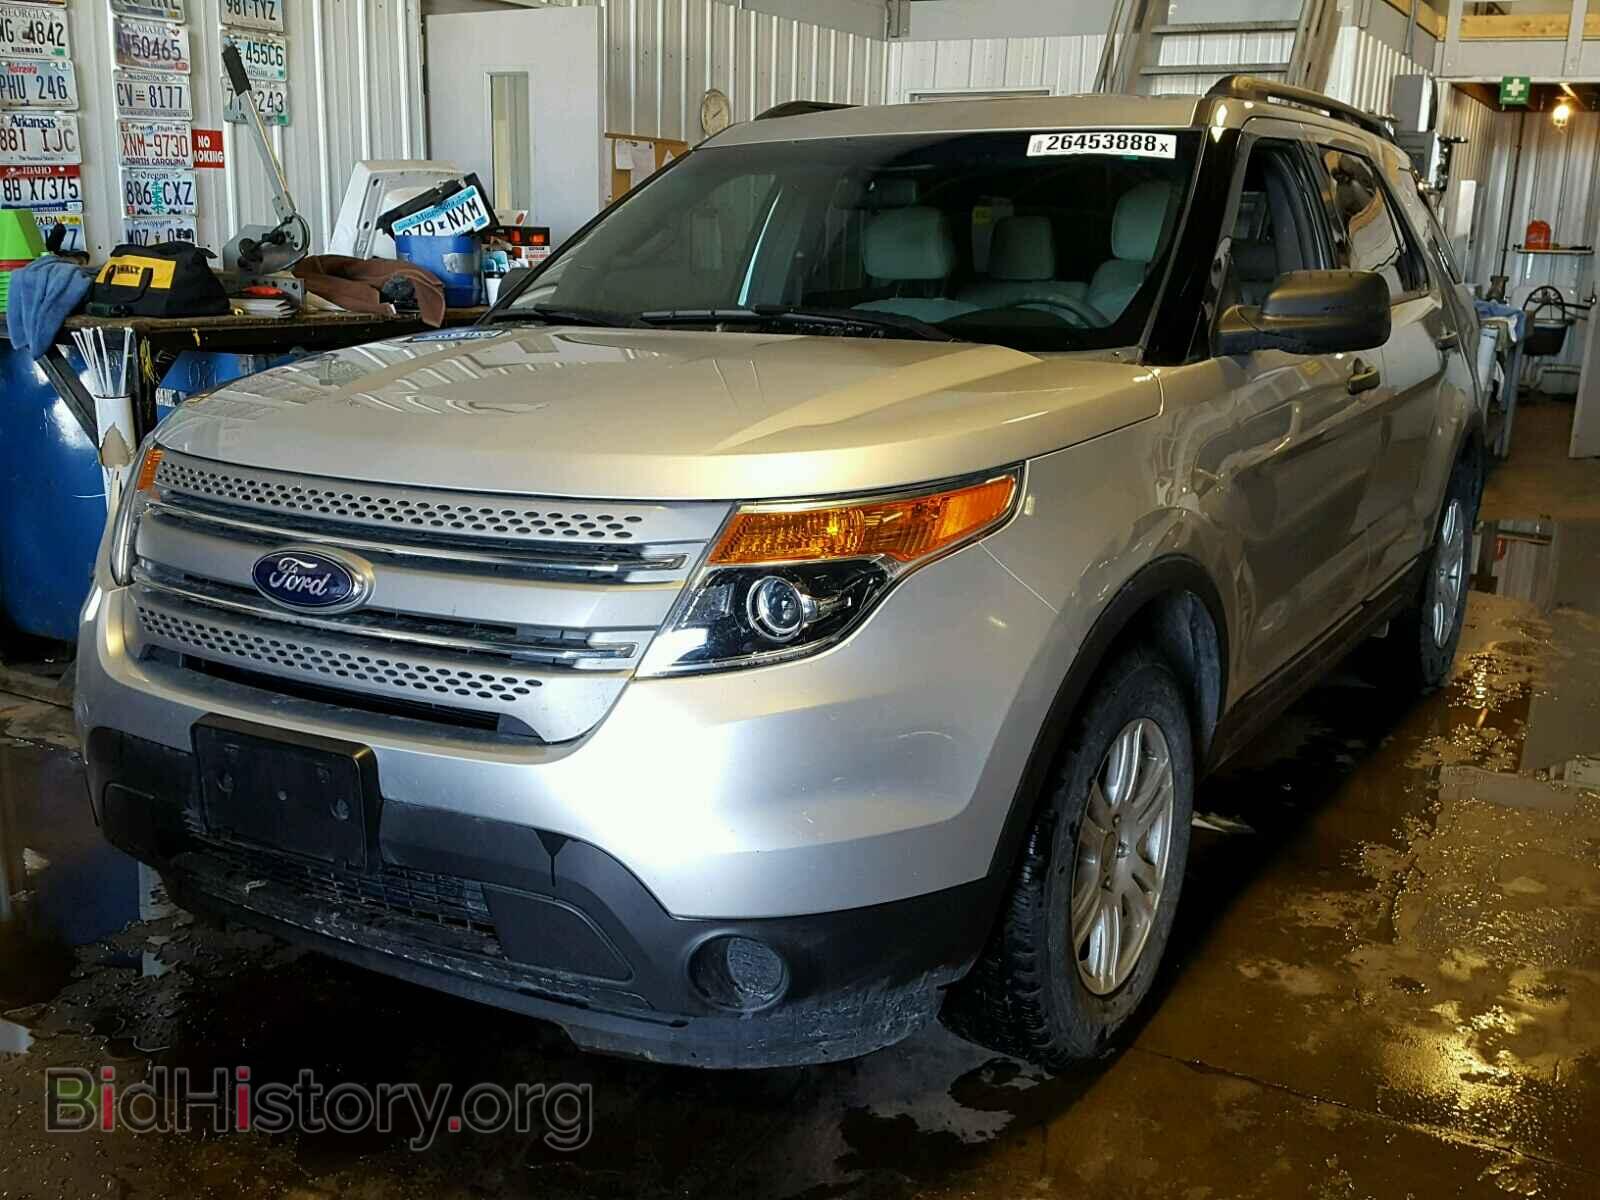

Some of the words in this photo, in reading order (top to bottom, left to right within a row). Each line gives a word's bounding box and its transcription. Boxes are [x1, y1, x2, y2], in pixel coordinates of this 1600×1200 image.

[2, 7, 48, 19] GEORGIA
[28, 20, 66, 47] 4842
[0, 75, 26, 100] PHU
[36, 75, 68, 100] 246
[117, 83, 134, 107] CV
[149, 84, 183, 109] 8177
[10, 114, 56, 129] Arkansas
[0, 128, 26, 152] 881
[41, 128, 76, 153] IJC
[122, 132, 189, 157] XNM-9730
[197, 135, 211, 148] NO
[23, 166, 52, 175] IDAHO
[126, 157, 149, 165] NORTH
[151, 158, 186, 166] CAROLINA
[140, 171, 169, 180] Oregon
[3, 177, 22, 202] 8B
[28, 175, 79, 201] X7375
[126, 180, 152, 206] 886
[162, 181, 194, 206] CXZ
[445, 197, 482, 231] NXM
[268, 556, 332, 597] Ford
